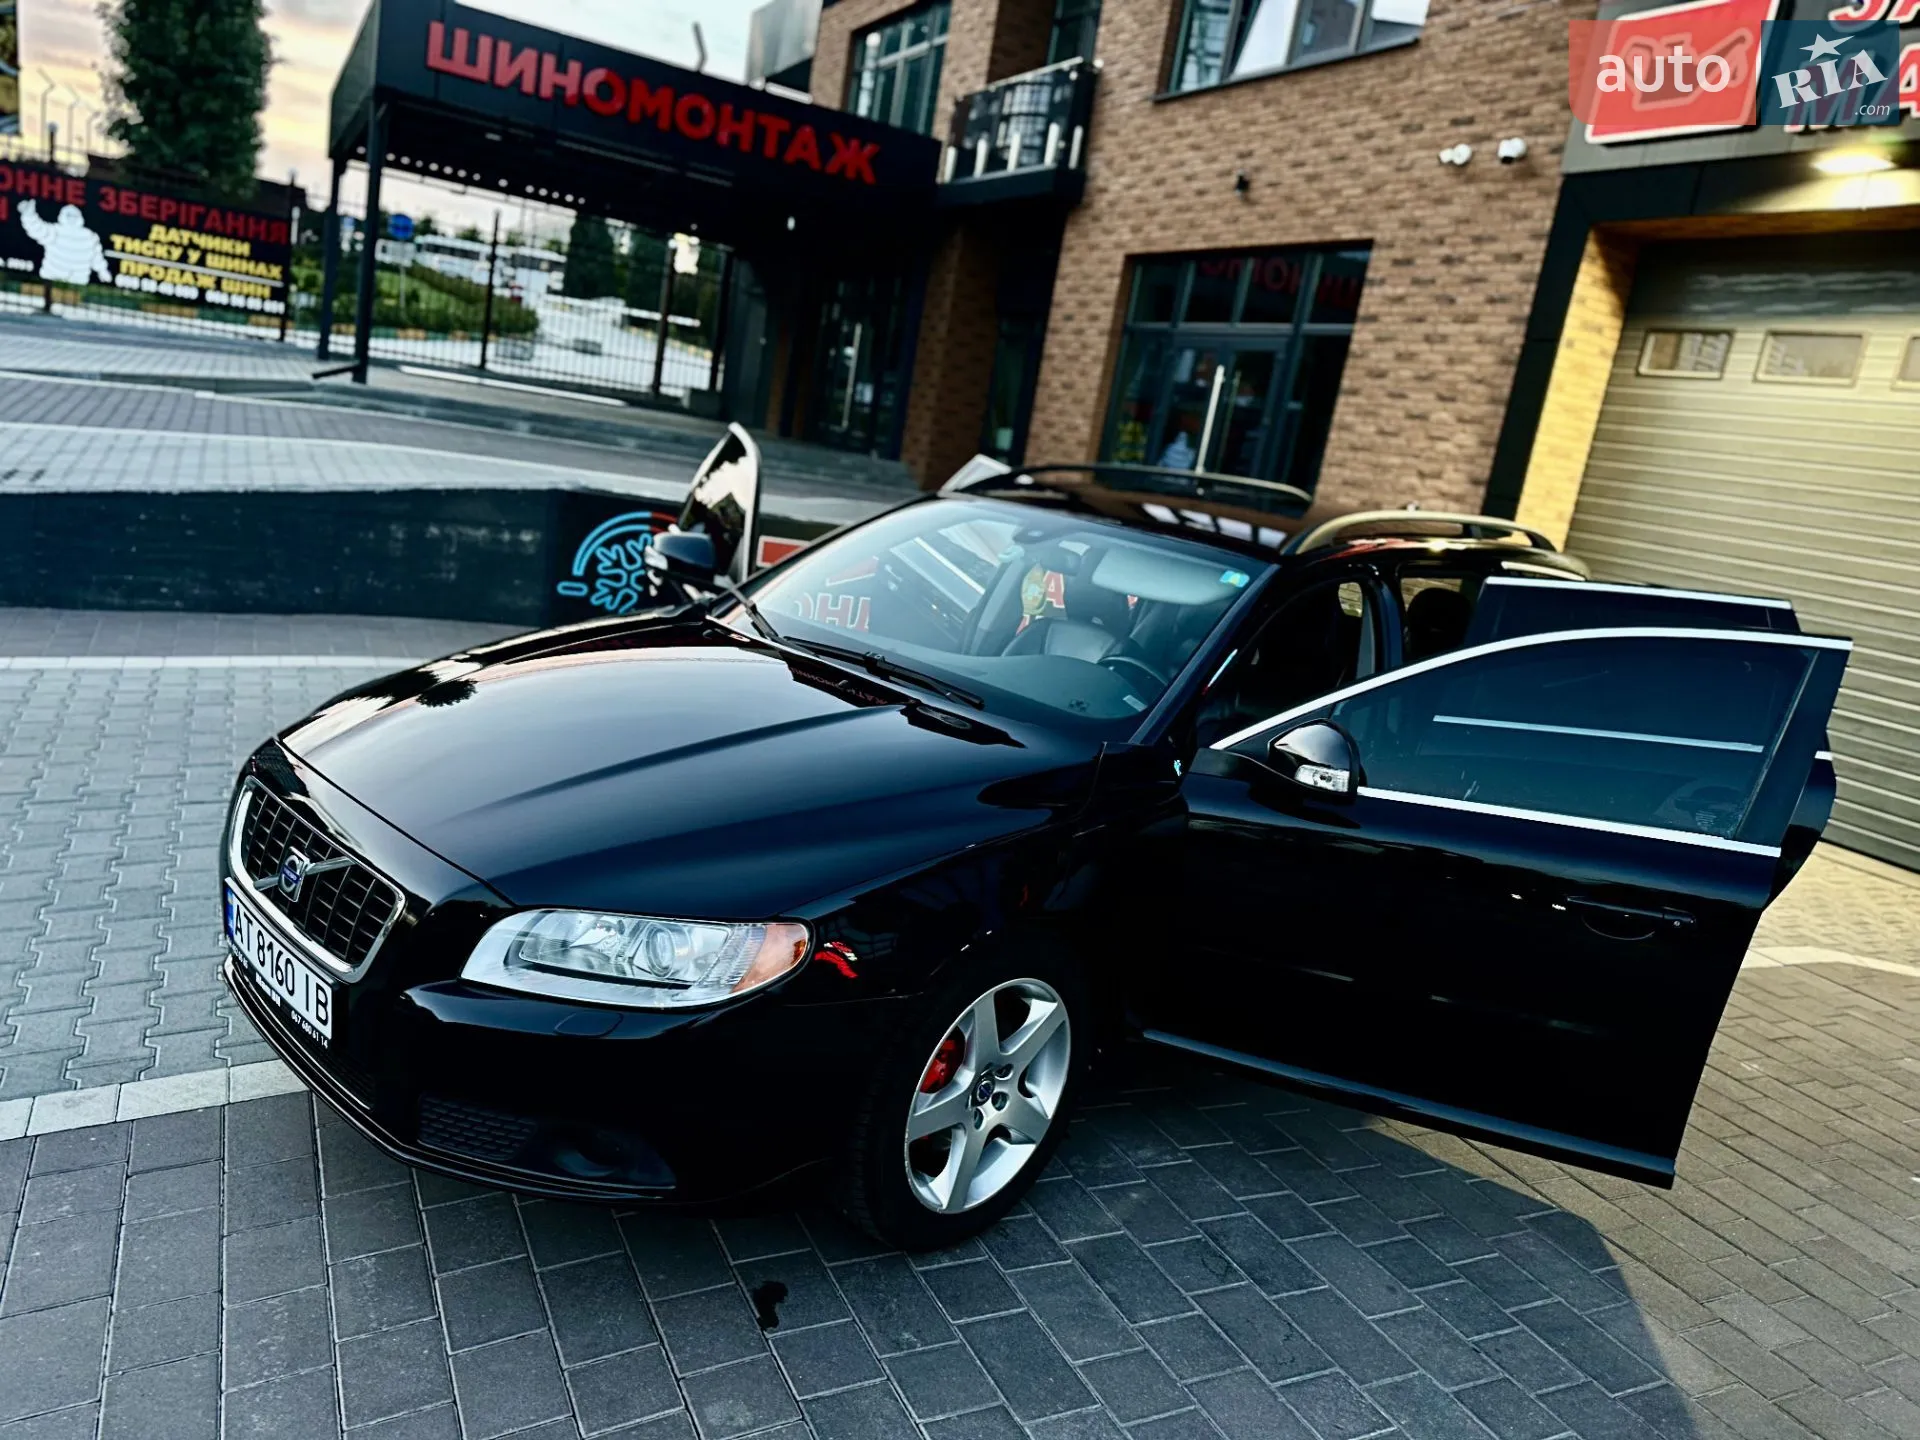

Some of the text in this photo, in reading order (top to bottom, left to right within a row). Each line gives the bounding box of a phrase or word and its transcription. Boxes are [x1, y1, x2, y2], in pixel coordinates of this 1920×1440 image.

[426, 20, 881, 185] ШИНОМОНТАЖ
[97, 185, 289, 246] ЗБЕРІГАННЯ
[149, 223, 252, 257] ДАТЧИКИ
[109, 233, 283, 281] ТИСКУ У ШИНАХ
[119, 259, 217, 291] ПРОДАЖ
[220, 277, 271, 300] ШИН
[235, 904, 253, 952] AT
[257, 929, 295, 997] 8160
[305, 973, 329, 1027] IB
